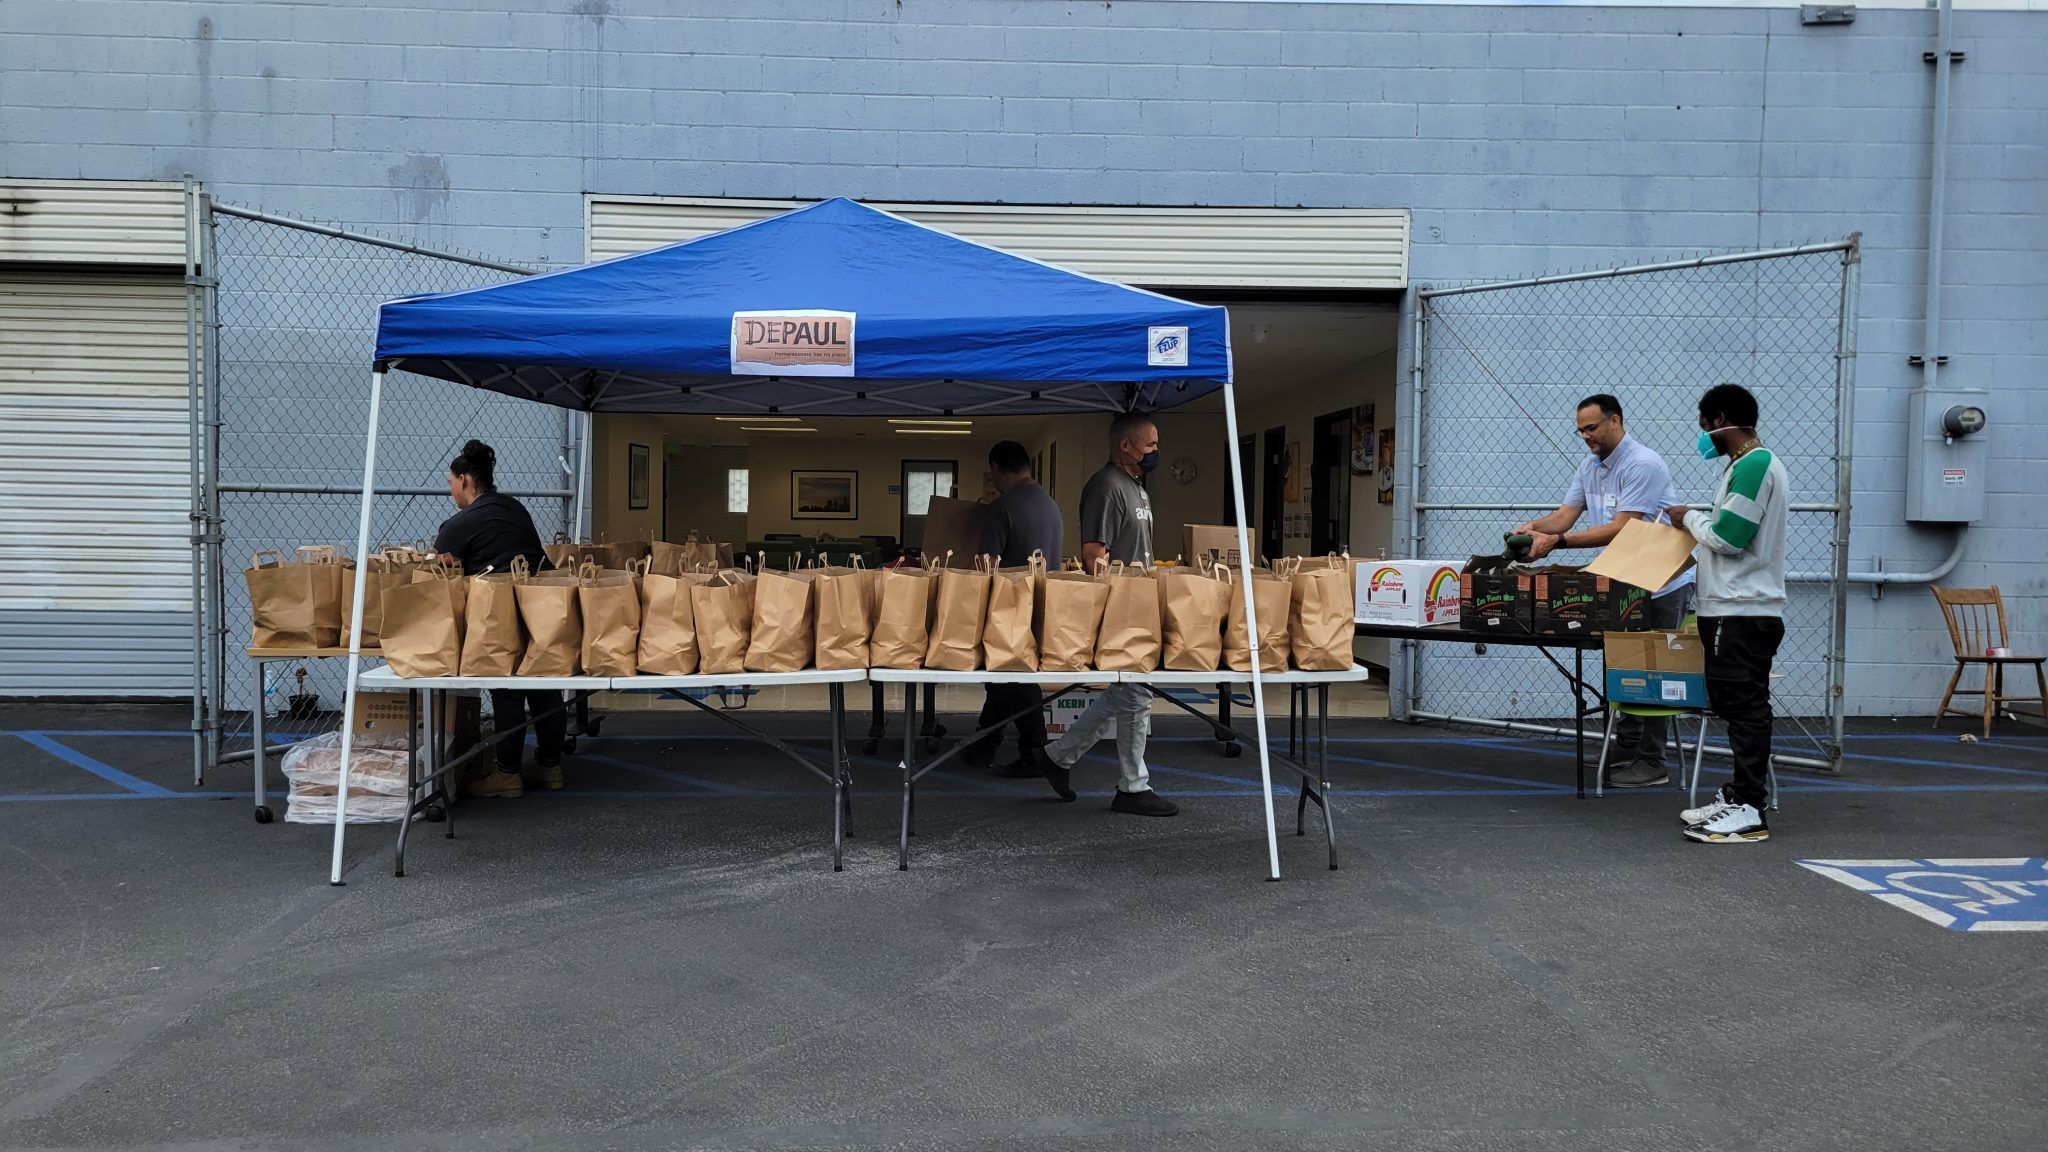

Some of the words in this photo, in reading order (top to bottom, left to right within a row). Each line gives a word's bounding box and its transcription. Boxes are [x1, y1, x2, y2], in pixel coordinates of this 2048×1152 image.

[744, 320, 846, 345] DEPAUL
[1553, 599, 1563, 609] Los
[1563, 595, 1581, 604] Pinos
[1058, 699, 1085, 708] KERN
